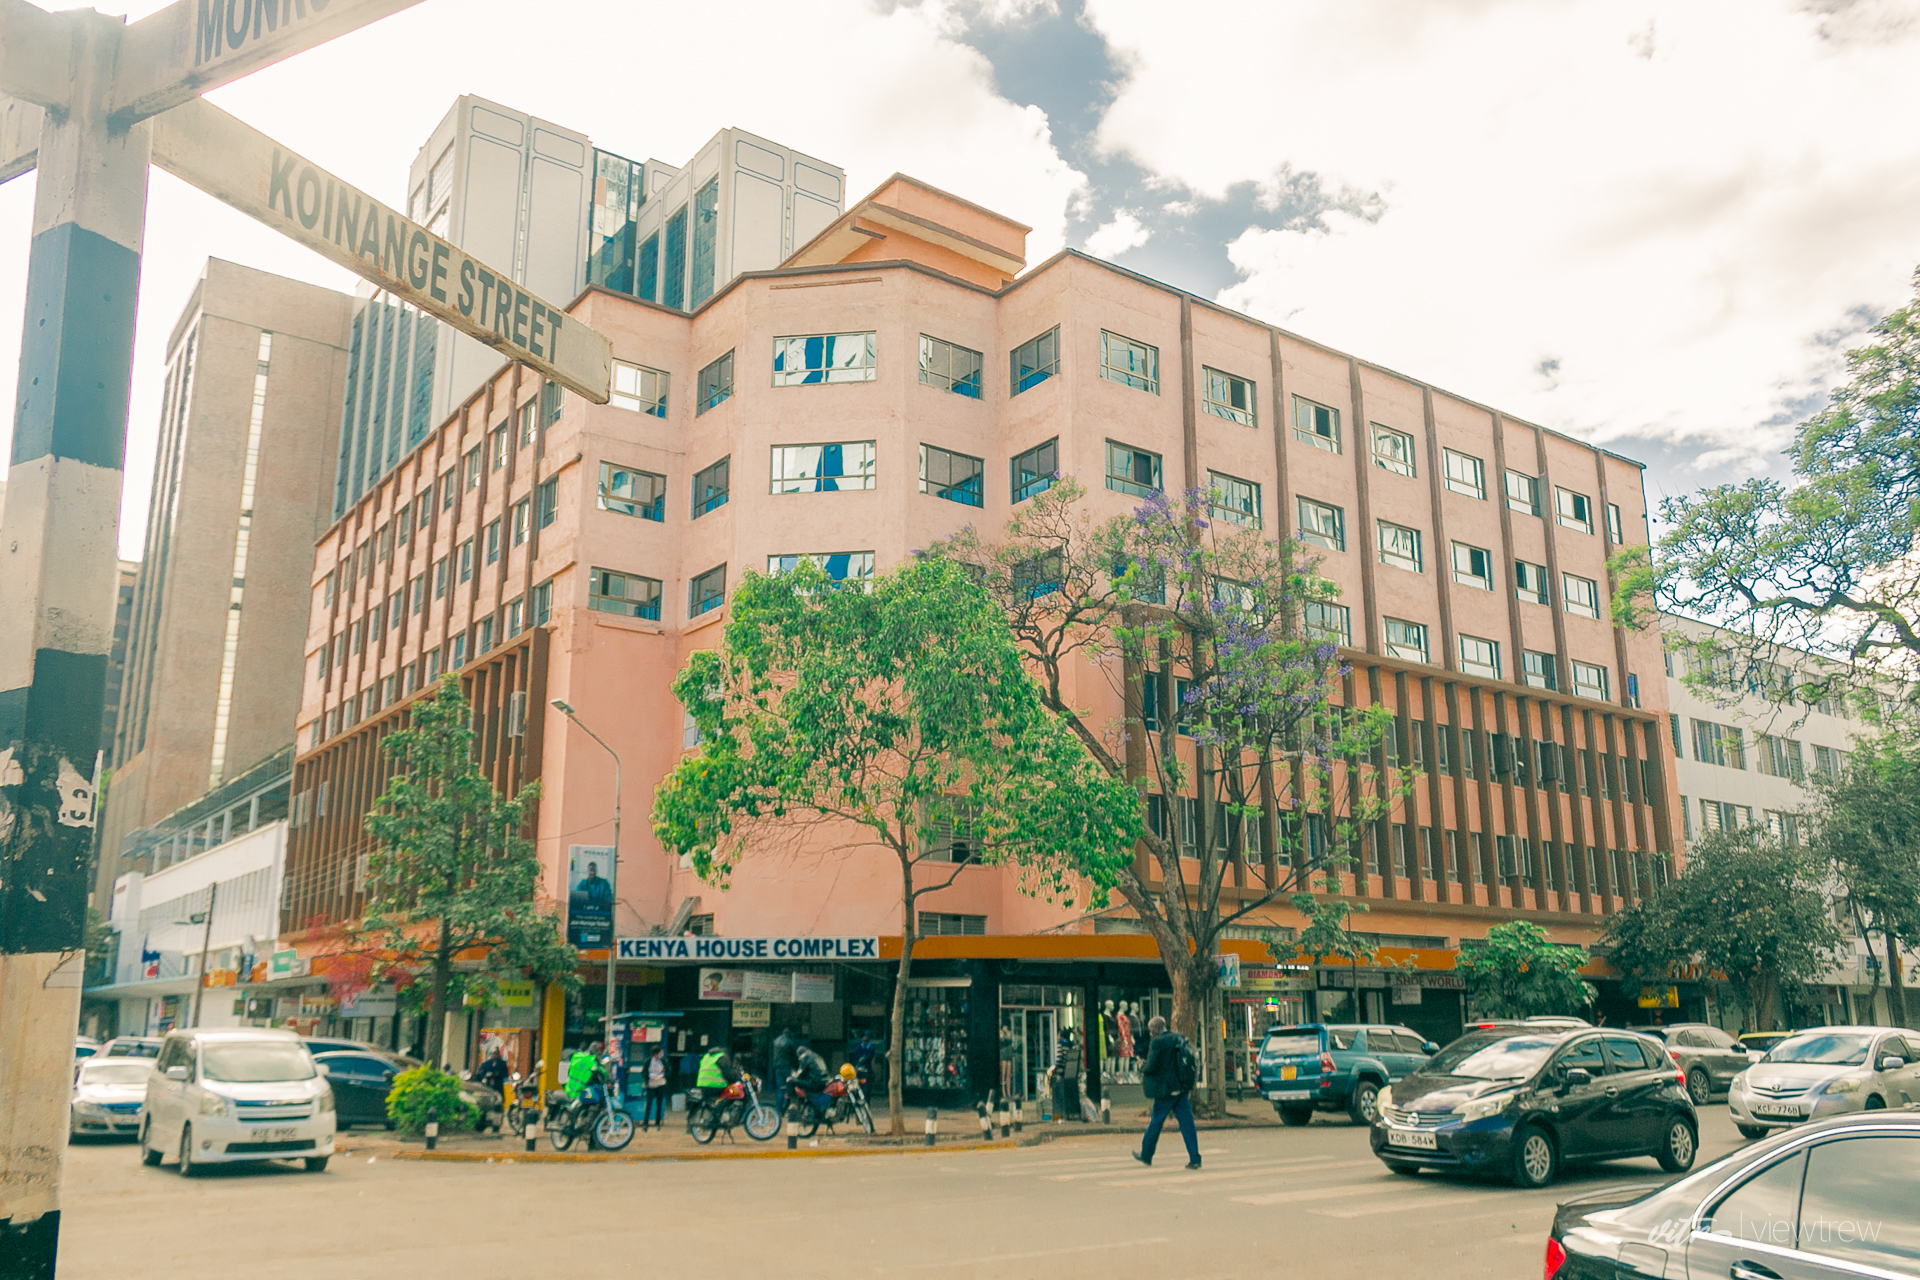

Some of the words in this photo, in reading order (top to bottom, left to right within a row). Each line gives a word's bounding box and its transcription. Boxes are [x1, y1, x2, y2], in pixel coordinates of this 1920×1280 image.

[267, 147, 449, 304] KOINANGE
[457, 259, 563, 365] STREET
[620, 940, 689, 958] KENYA
[696, 940, 767, 957] HOUSE
[773, 939, 876, 957] COMPLEX
[1396, 976, 1424, 986] SHOE
[1428, 976, 1464, 988] WORLD
[1390, 1133, 1407, 1144] KDB
